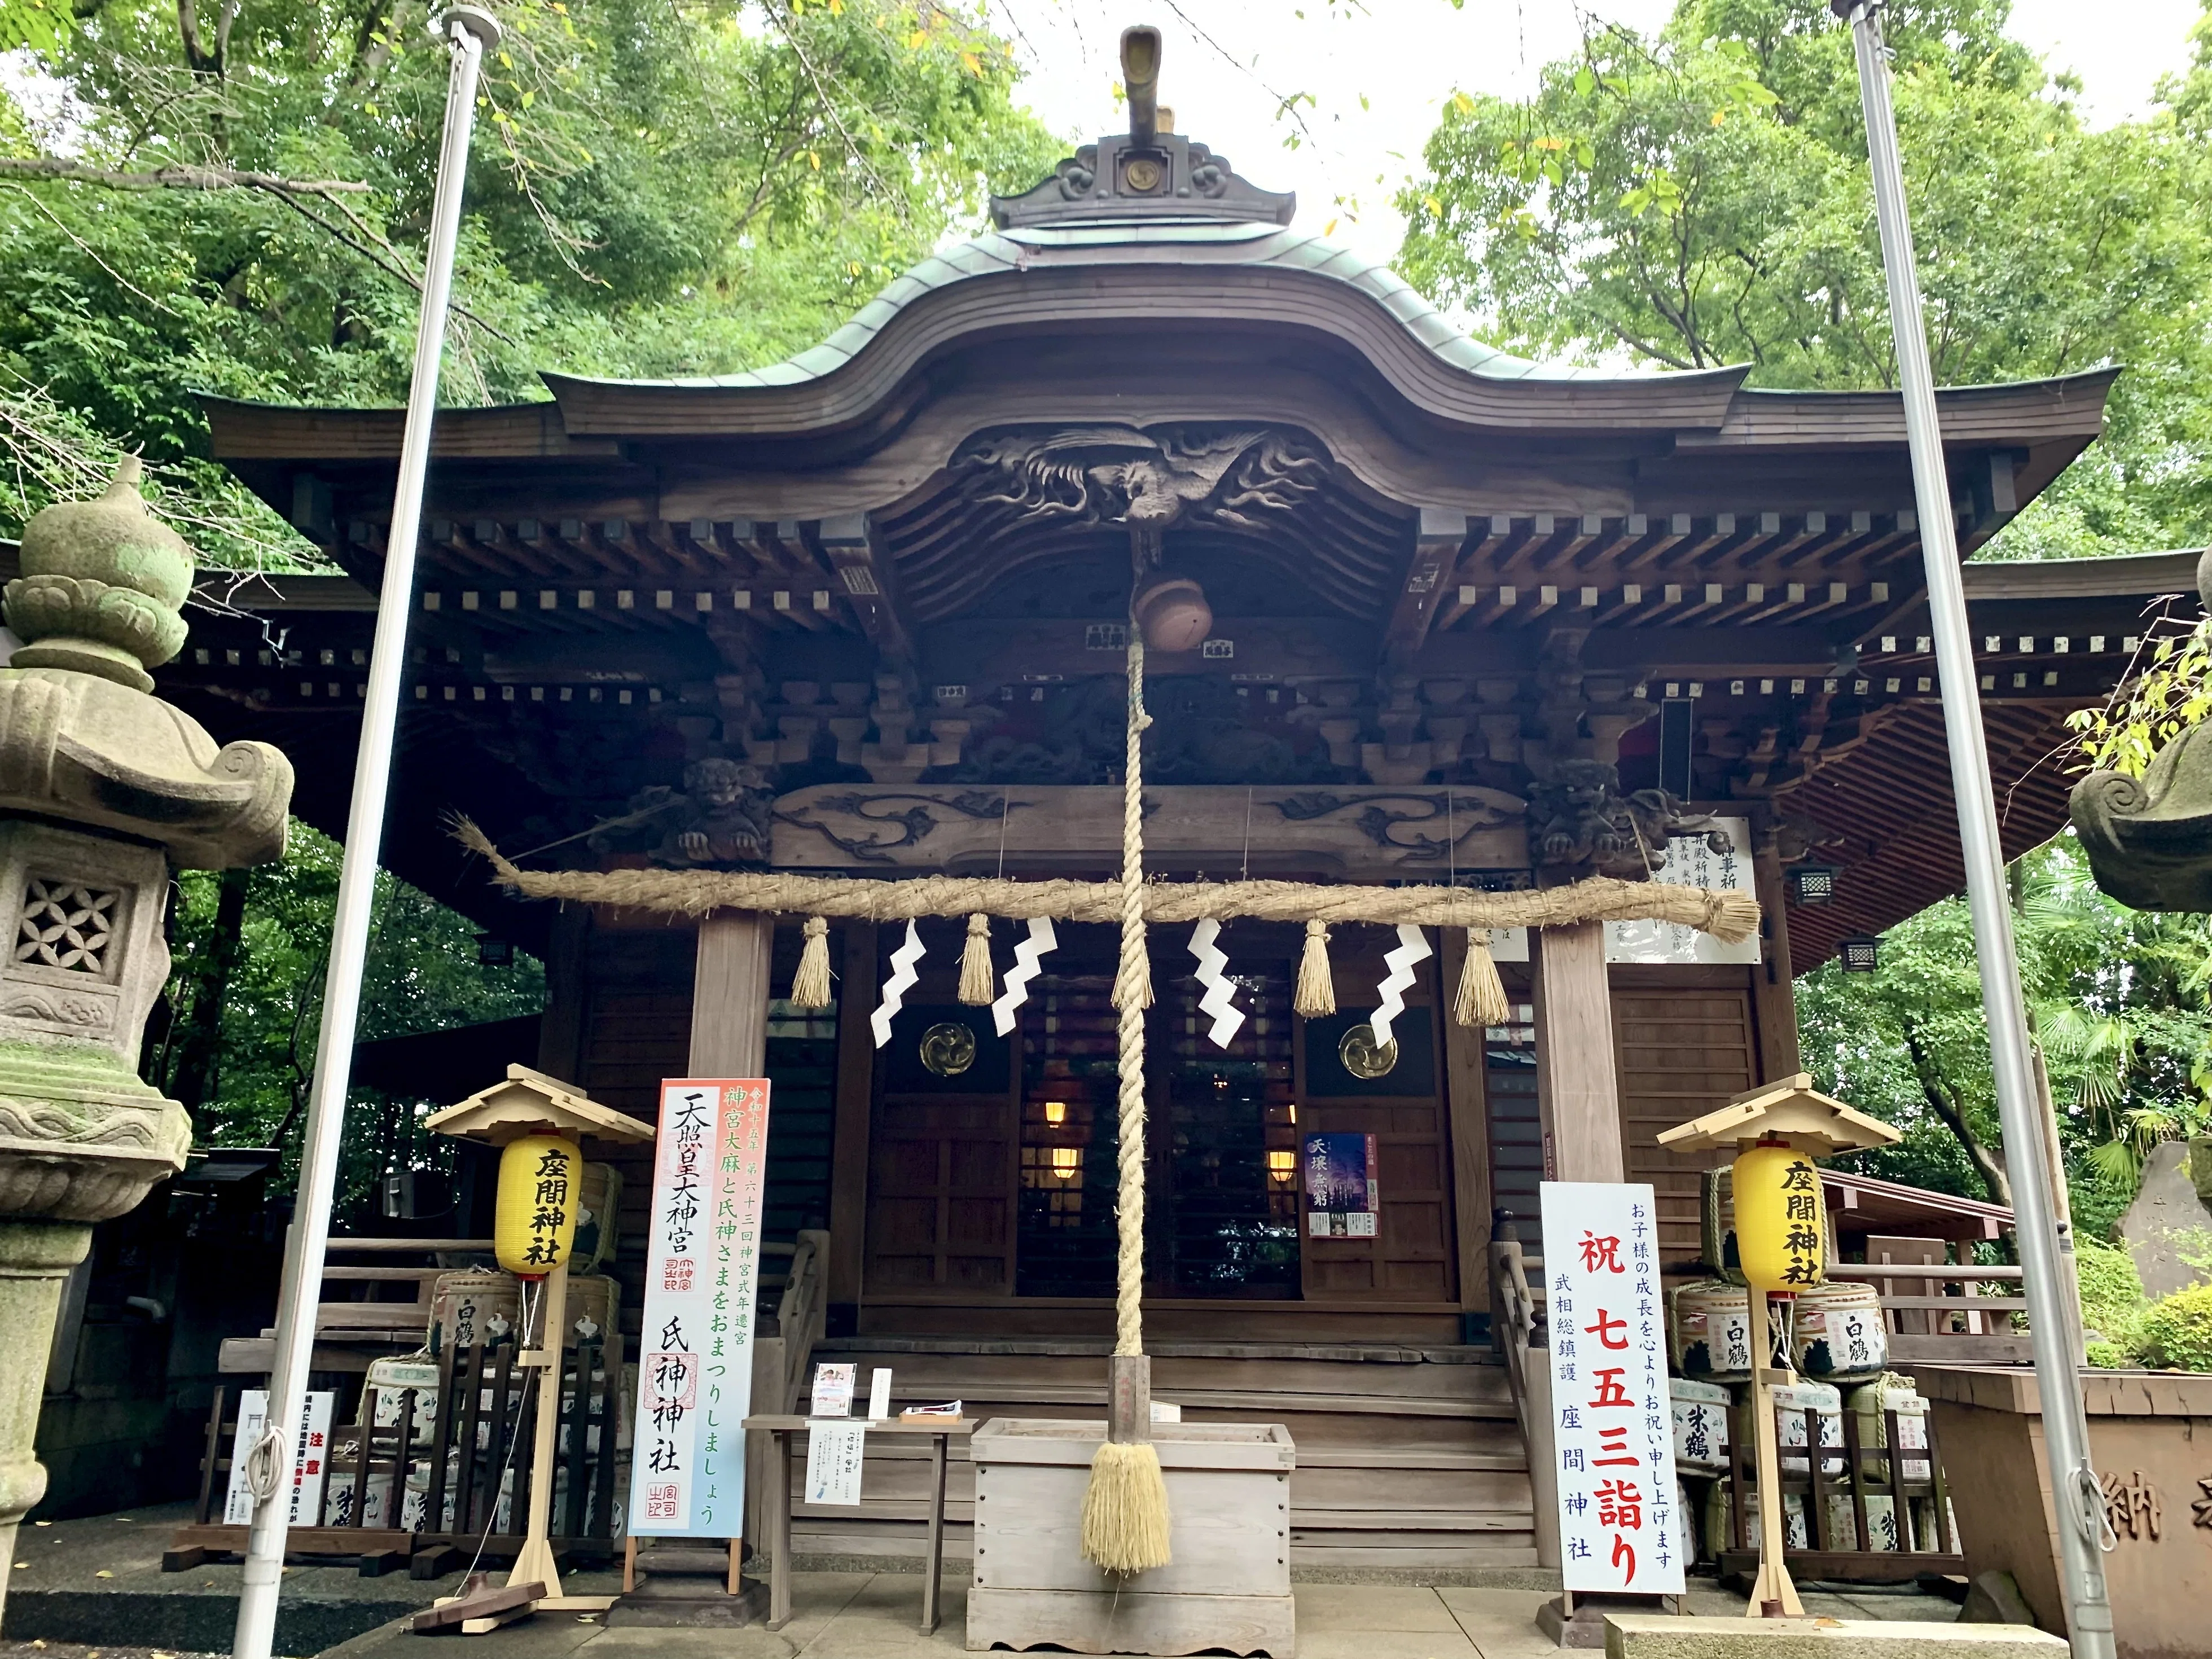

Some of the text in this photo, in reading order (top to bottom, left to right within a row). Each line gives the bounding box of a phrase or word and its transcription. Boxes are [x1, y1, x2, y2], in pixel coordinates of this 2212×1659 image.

[522, 1148, 570, 1266] 座間神社
[665, 1094, 712, 1254] 天照皇大神宮
[734, 1086, 764, 1346] 令和十五年 第六十三回神宮式年遷宮
[1779, 1161, 1819, 1285] 座間神社
[700, 1086, 746, 1526] 神宮大麻と氏神さまをおまつりしましょう
[1727, 1319, 1748, 1366] 白鶴
[1845, 1315, 1869, 1363] 白鶴
[306, 1432, 324, 1475] 注意
[649, 1315, 690, 1476] 氏神神社
[1555, 1274, 1592, 1561] 武相総鎮護 座間神社
[1578, 1229, 1642, 1588] 祝 七五三詣り
[1631, 1204, 1673, 1570] お子様の成長を心よりお祝い申し上げます
